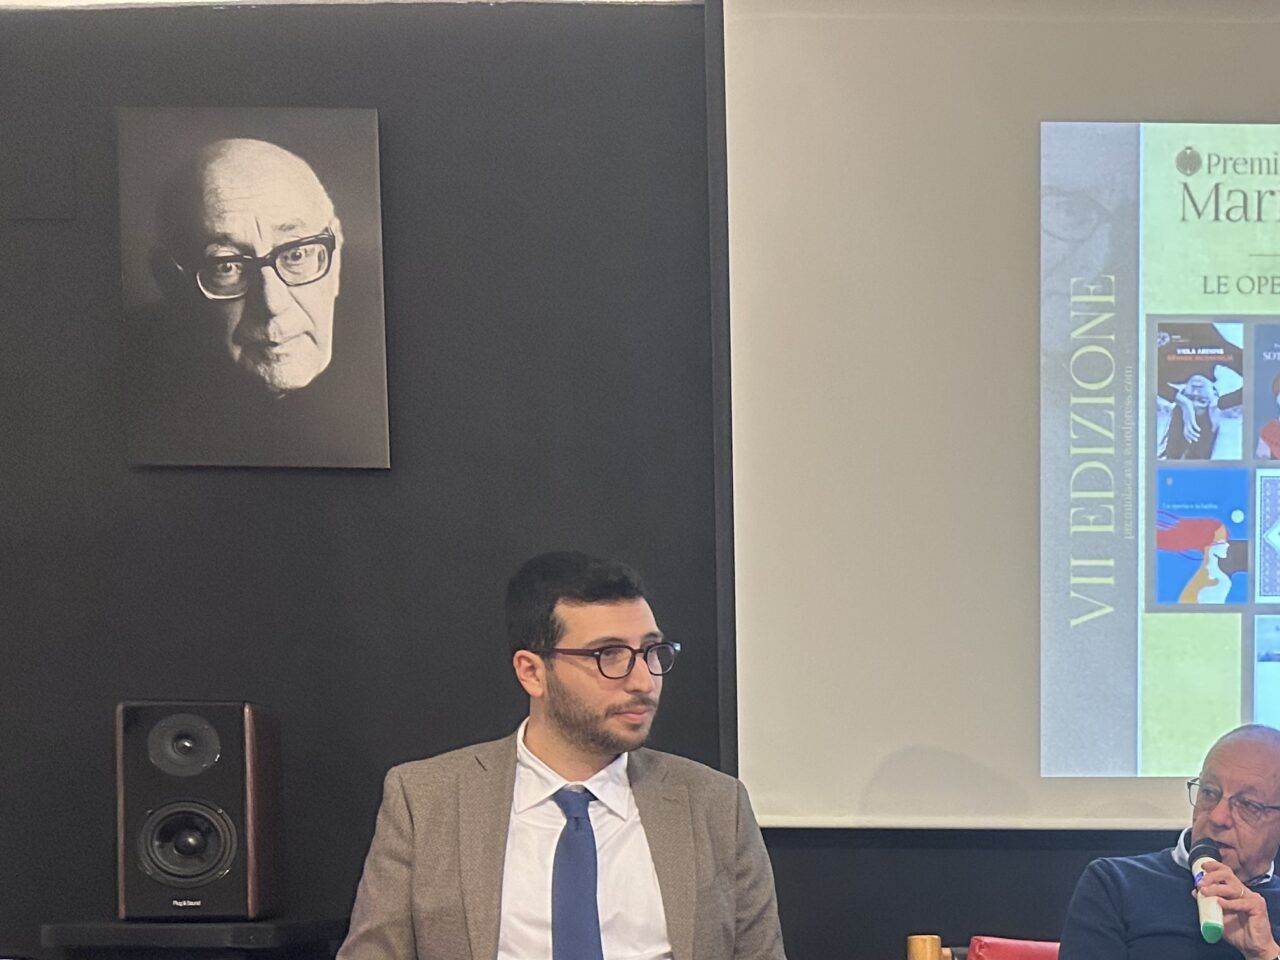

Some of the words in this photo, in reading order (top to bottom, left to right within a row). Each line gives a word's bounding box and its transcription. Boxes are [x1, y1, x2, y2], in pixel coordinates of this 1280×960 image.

[1202, 275, 1230, 296] LE
[1069, 275, 1116, 536] EDIZIONE
[1069, 557, 1115, 628] VII
